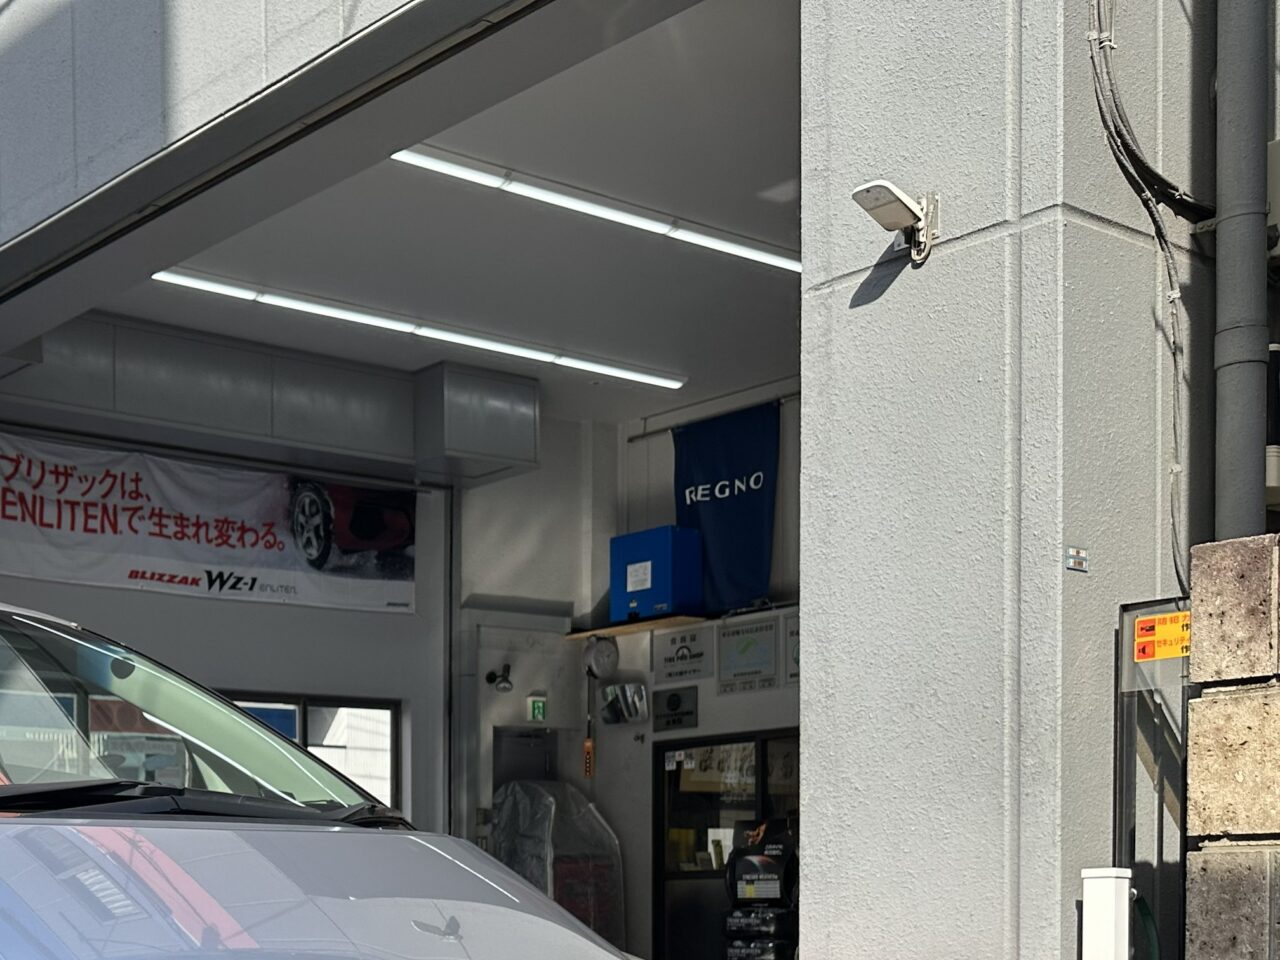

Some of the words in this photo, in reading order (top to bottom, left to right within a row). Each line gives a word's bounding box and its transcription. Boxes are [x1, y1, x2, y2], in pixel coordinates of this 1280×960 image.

[0, 453, 151, 502] ブリザックは、
[684, 471, 764, 505] REGNO
[127, 569, 203, 587] BLIZZAK
[204, 569, 258, 593] WZ-1
